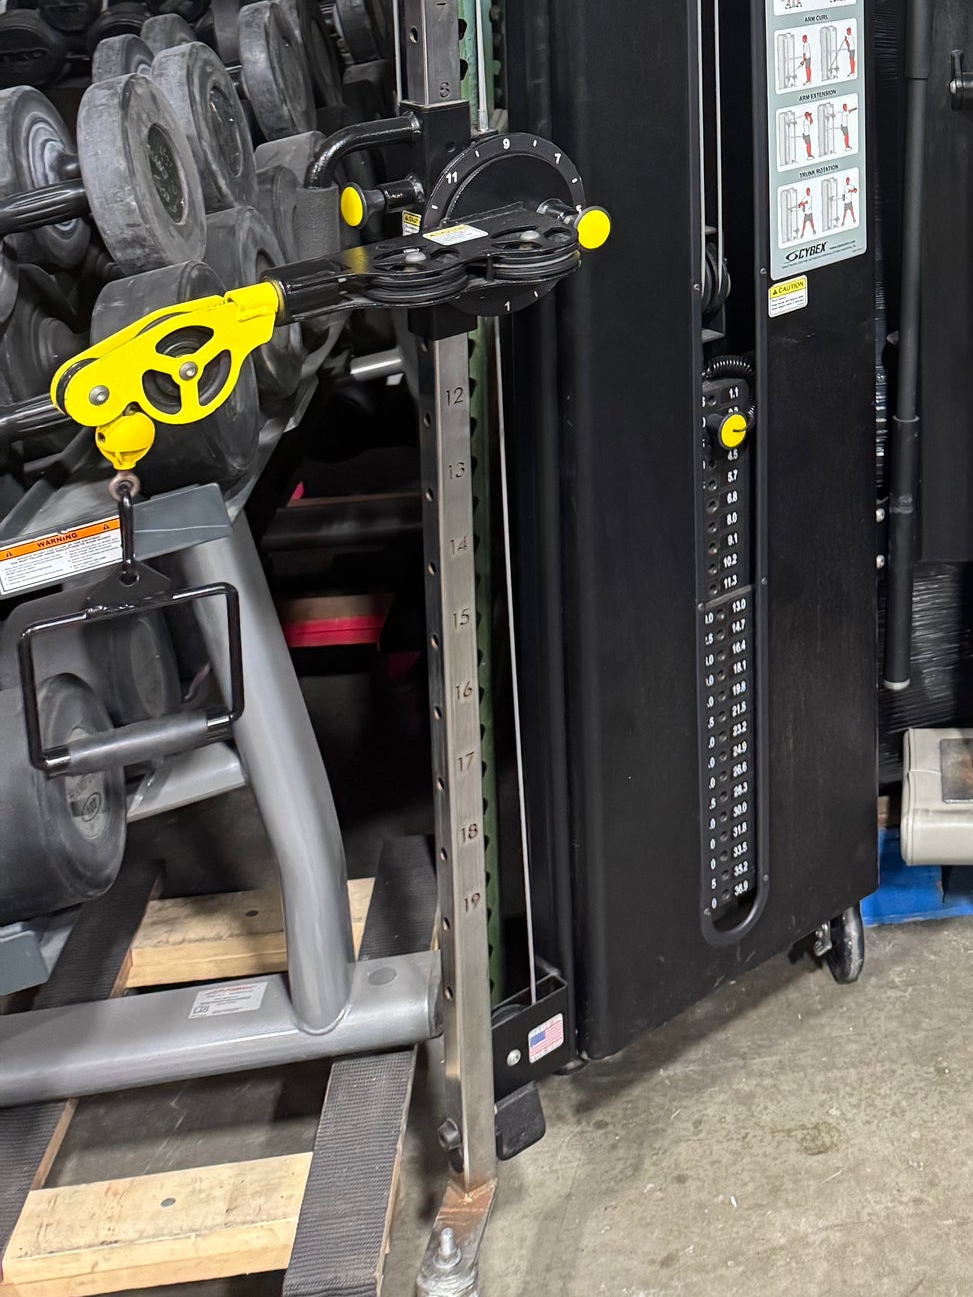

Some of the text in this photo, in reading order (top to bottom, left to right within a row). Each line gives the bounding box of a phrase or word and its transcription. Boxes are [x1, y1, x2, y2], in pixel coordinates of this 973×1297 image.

[436, 2, 446, 21] 7
[440, 82, 450, 98] 8
[503, 139, 510, 149] 9
[554, 153, 561, 164] 7
[446, 172, 458, 184] 11
[798, 242, 827, 259] CYBEX
[779, 282, 804, 294] CAUTION
[504, 301, 510, 311] 1
[445, 386, 464, 406] 12
[729, 387, 739, 399] 1.1
[448, 462, 465, 480] 13
[37, 532, 77, 547] WARNING
[450, 536, 467, 555] 14
[723, 554, 738, 568] 10.2
[724, 574, 738, 589] 11.3
[732, 598, 746, 613] 13.0
[453, 608, 470, 628] 15
[732, 618, 745, 633] 14.7
[456, 681, 473, 700] 16
[458, 751, 475, 772] 17
[734, 802, 747, 818] 30.0
[461, 823, 479, 843] 18
[733, 822, 747, 837] 31.8
[464, 893, 480, 912] 19
